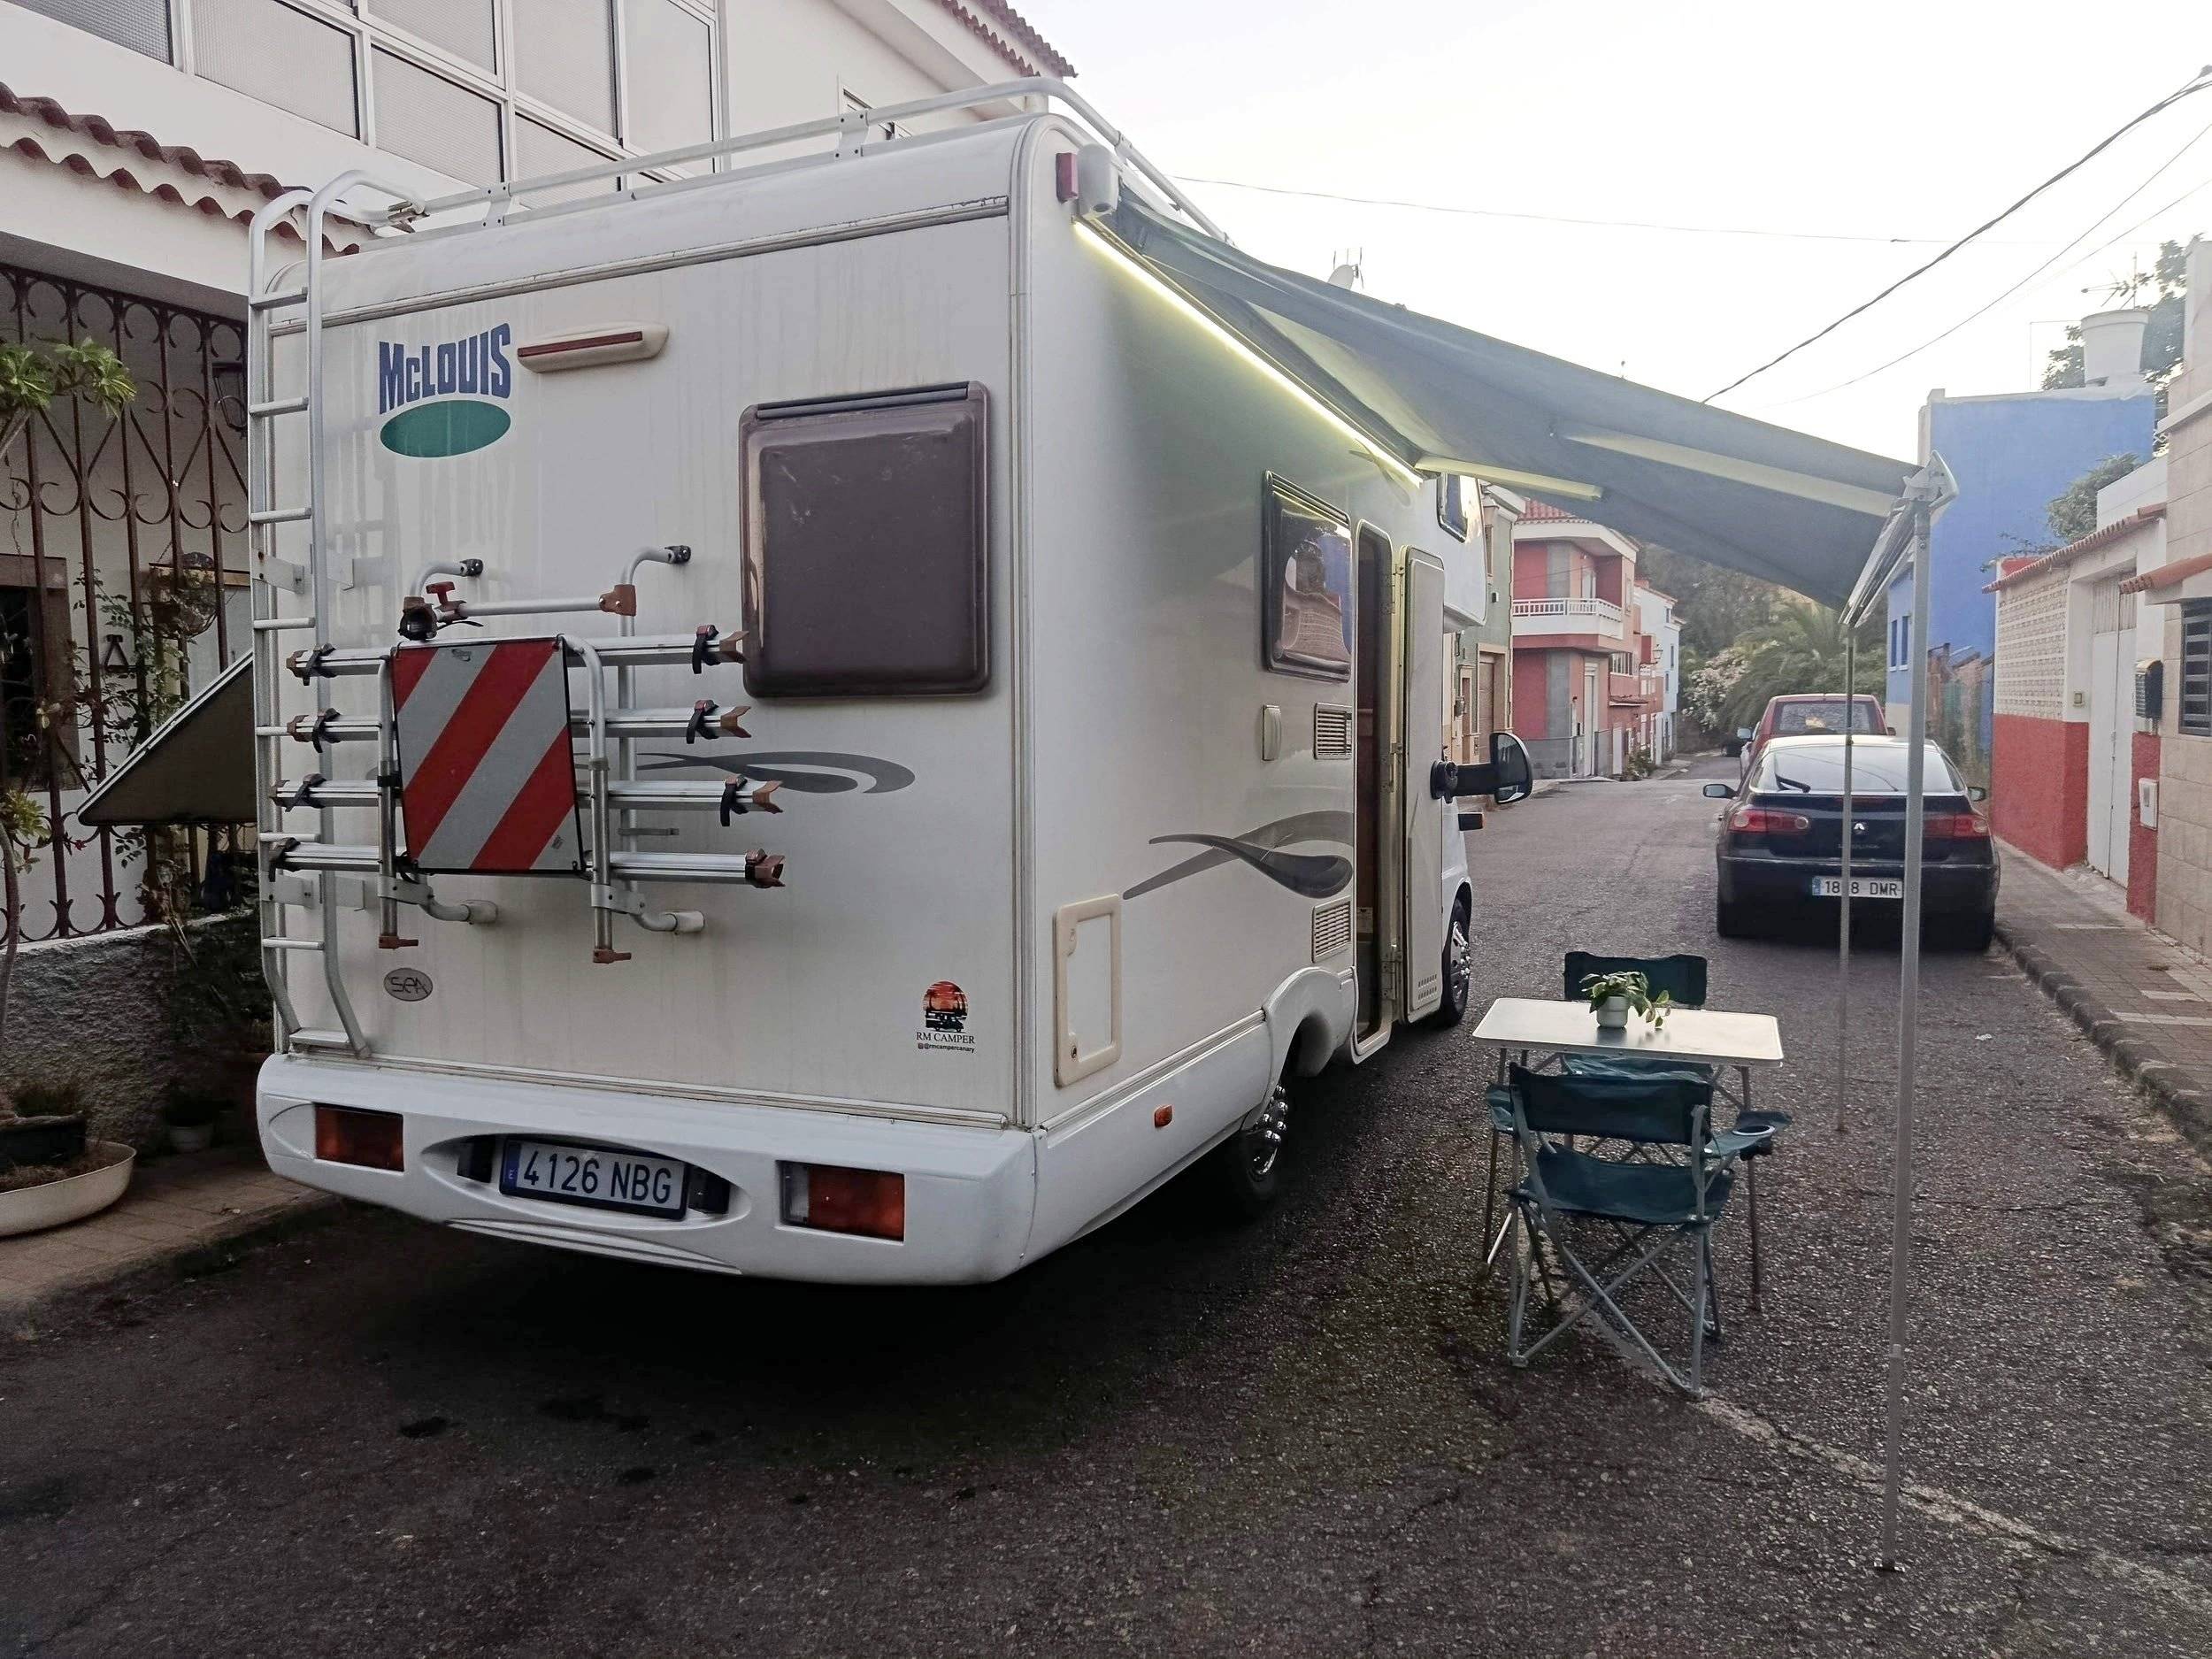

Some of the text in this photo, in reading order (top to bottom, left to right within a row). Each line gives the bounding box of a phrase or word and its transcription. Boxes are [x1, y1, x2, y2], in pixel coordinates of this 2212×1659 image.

[379, 323, 511, 415] McLOUIS
[1825, 880, 1898, 896] 188 DMR
[916, 1032, 975, 1043] RM CAMPER
[523, 1151, 672, 1204] 4126 NBG
